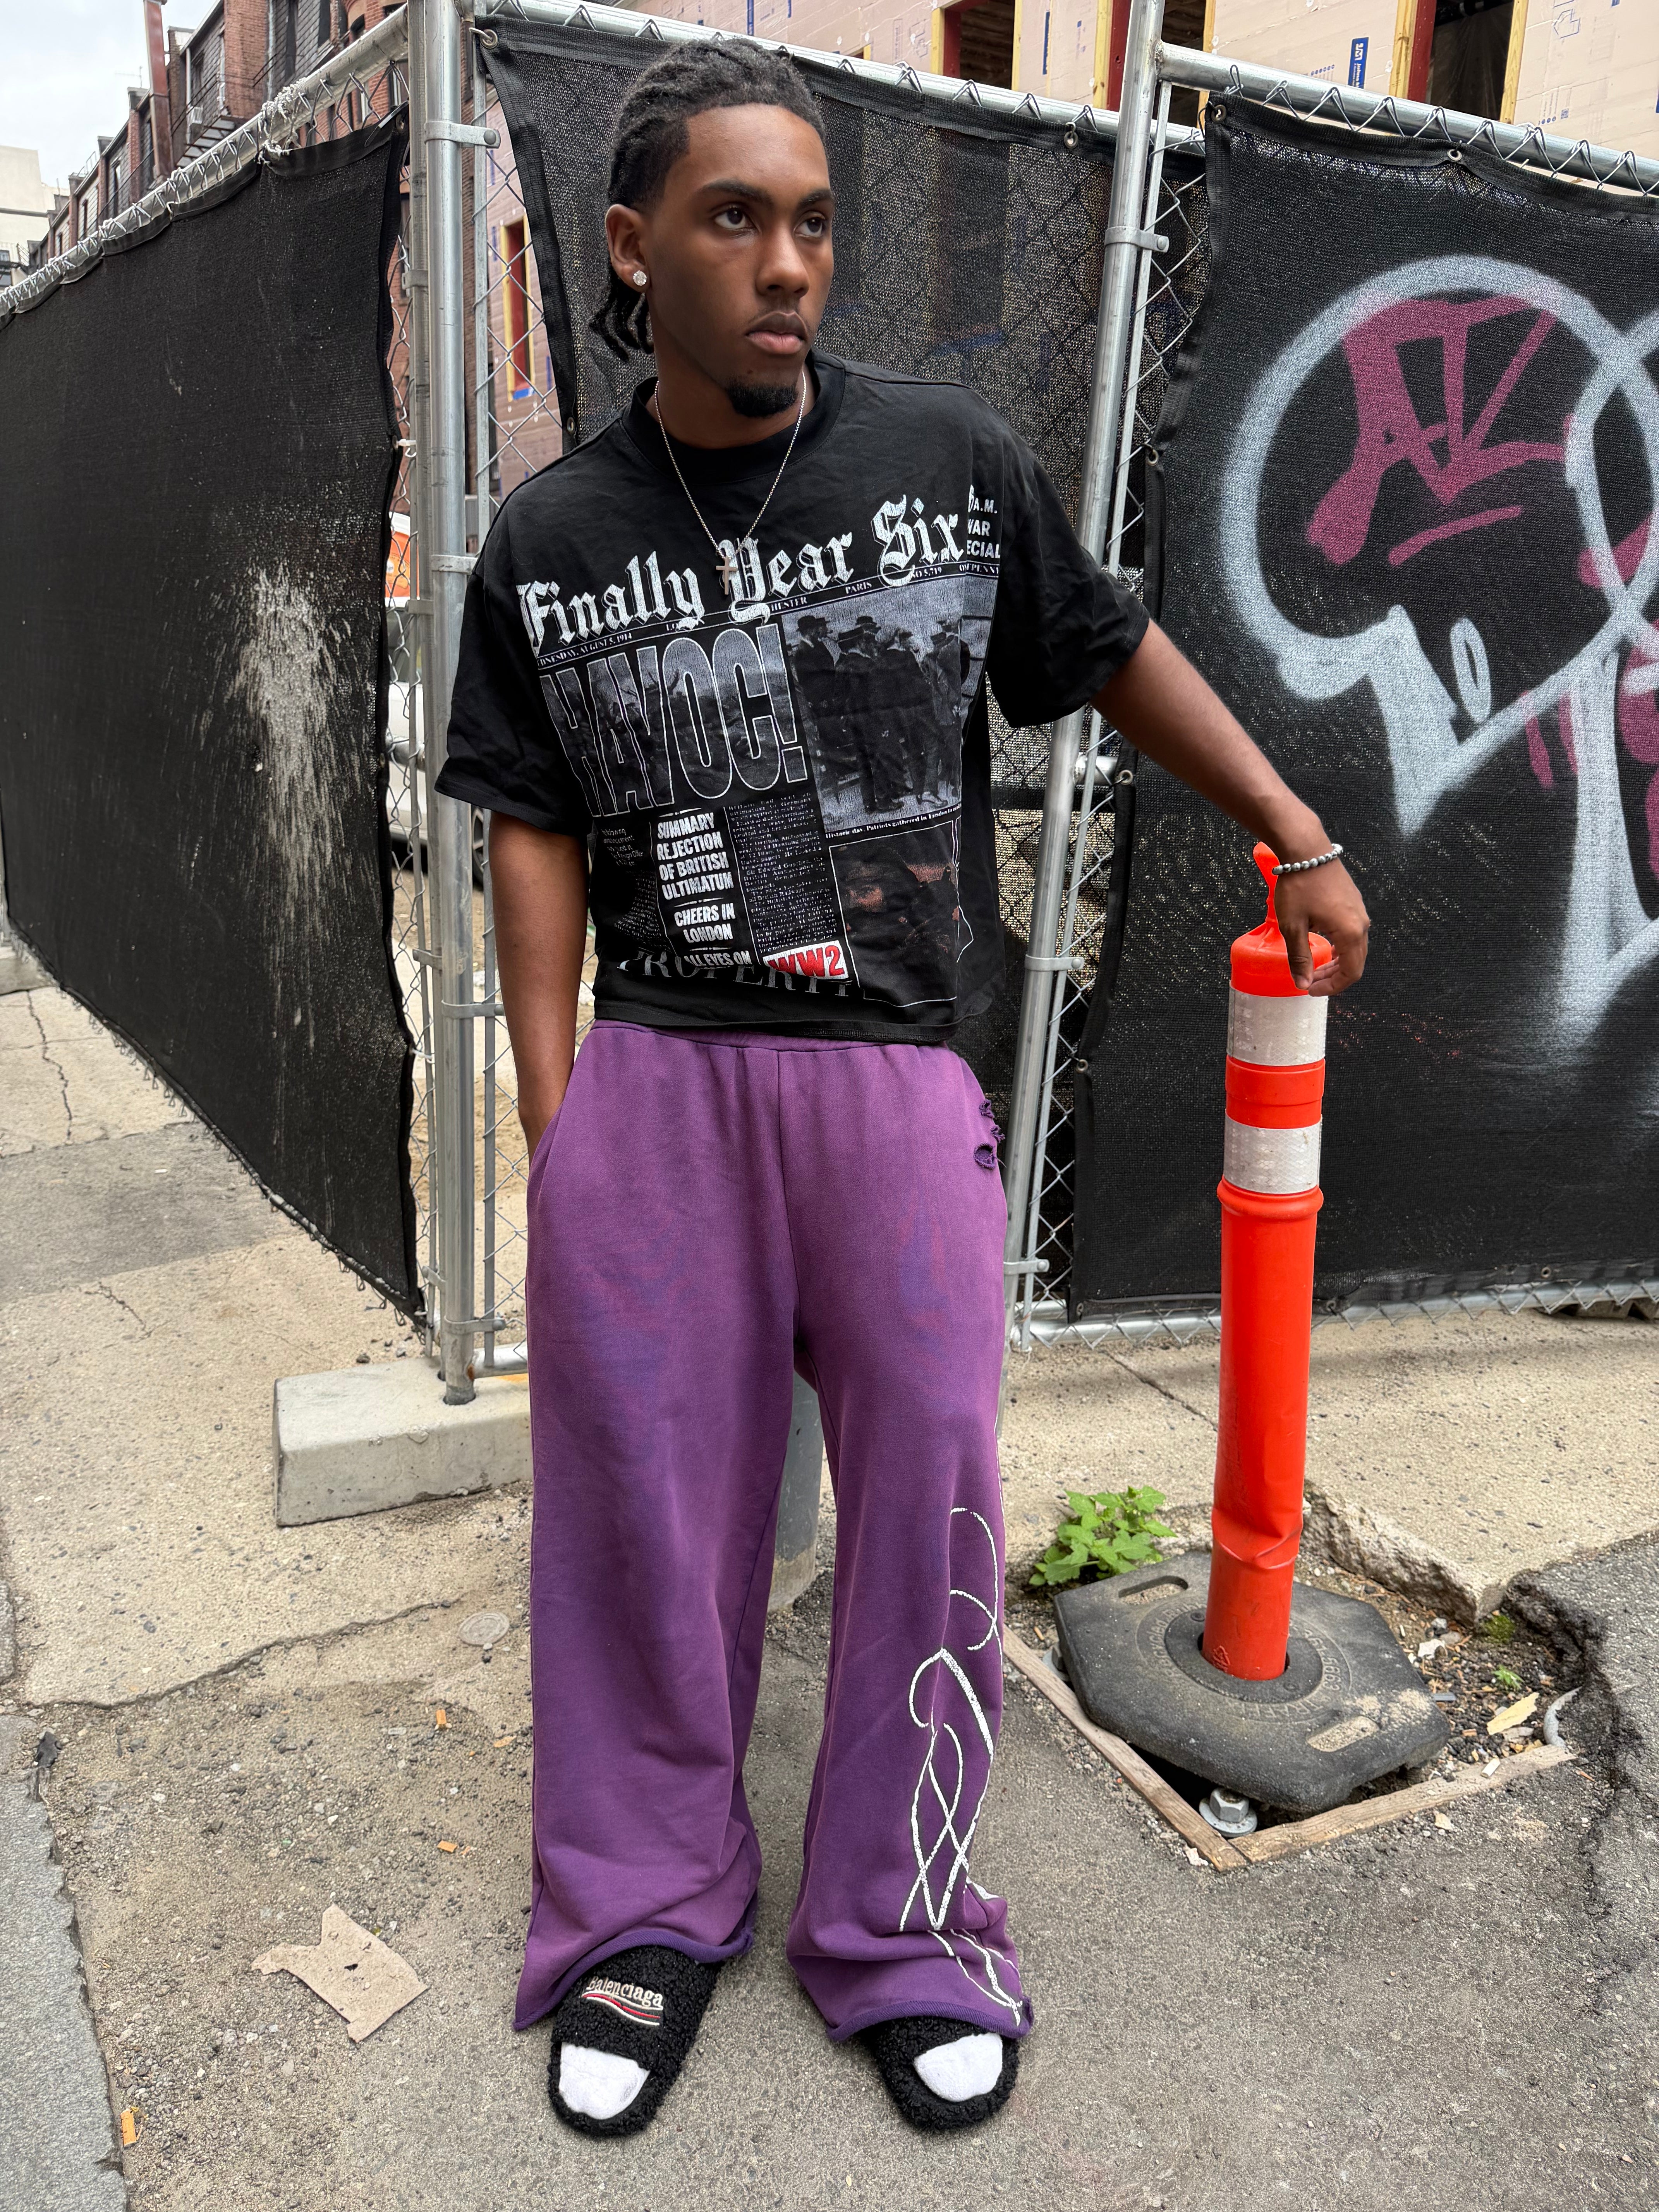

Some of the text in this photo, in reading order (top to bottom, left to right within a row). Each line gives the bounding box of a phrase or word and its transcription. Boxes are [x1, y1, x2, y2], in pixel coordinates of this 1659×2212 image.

[967, 540, 1000, 558] ECIAL
[516, 551, 705, 658] Finally
[871, 495, 964, 589] Six
[617, 632, 633, 643] 1914
[771, 597, 807, 611] HESTER
[845, 581, 872, 594] PARIS
[539, 623, 808, 817] HAVOC!
[658, 812, 714, 840] SUMMARY
[867, 823, 891, 831] Patriots
[892, 816, 920, 827] gathered
[657, 831, 723, 860] REJECTION
[659, 863, 675, 881] OF
[676, 852, 730, 878] BRITISH
[662, 872, 734, 900] ULTIMATUM
[674, 903, 736, 927] CHEERS IN
[683, 923, 733, 943] LONDON
[704, 952, 734, 966] EYES
[733, 950, 753, 965] ON
[767, 945, 845, 977] WW2
[586, 1976, 663, 2006] Balenciaga
